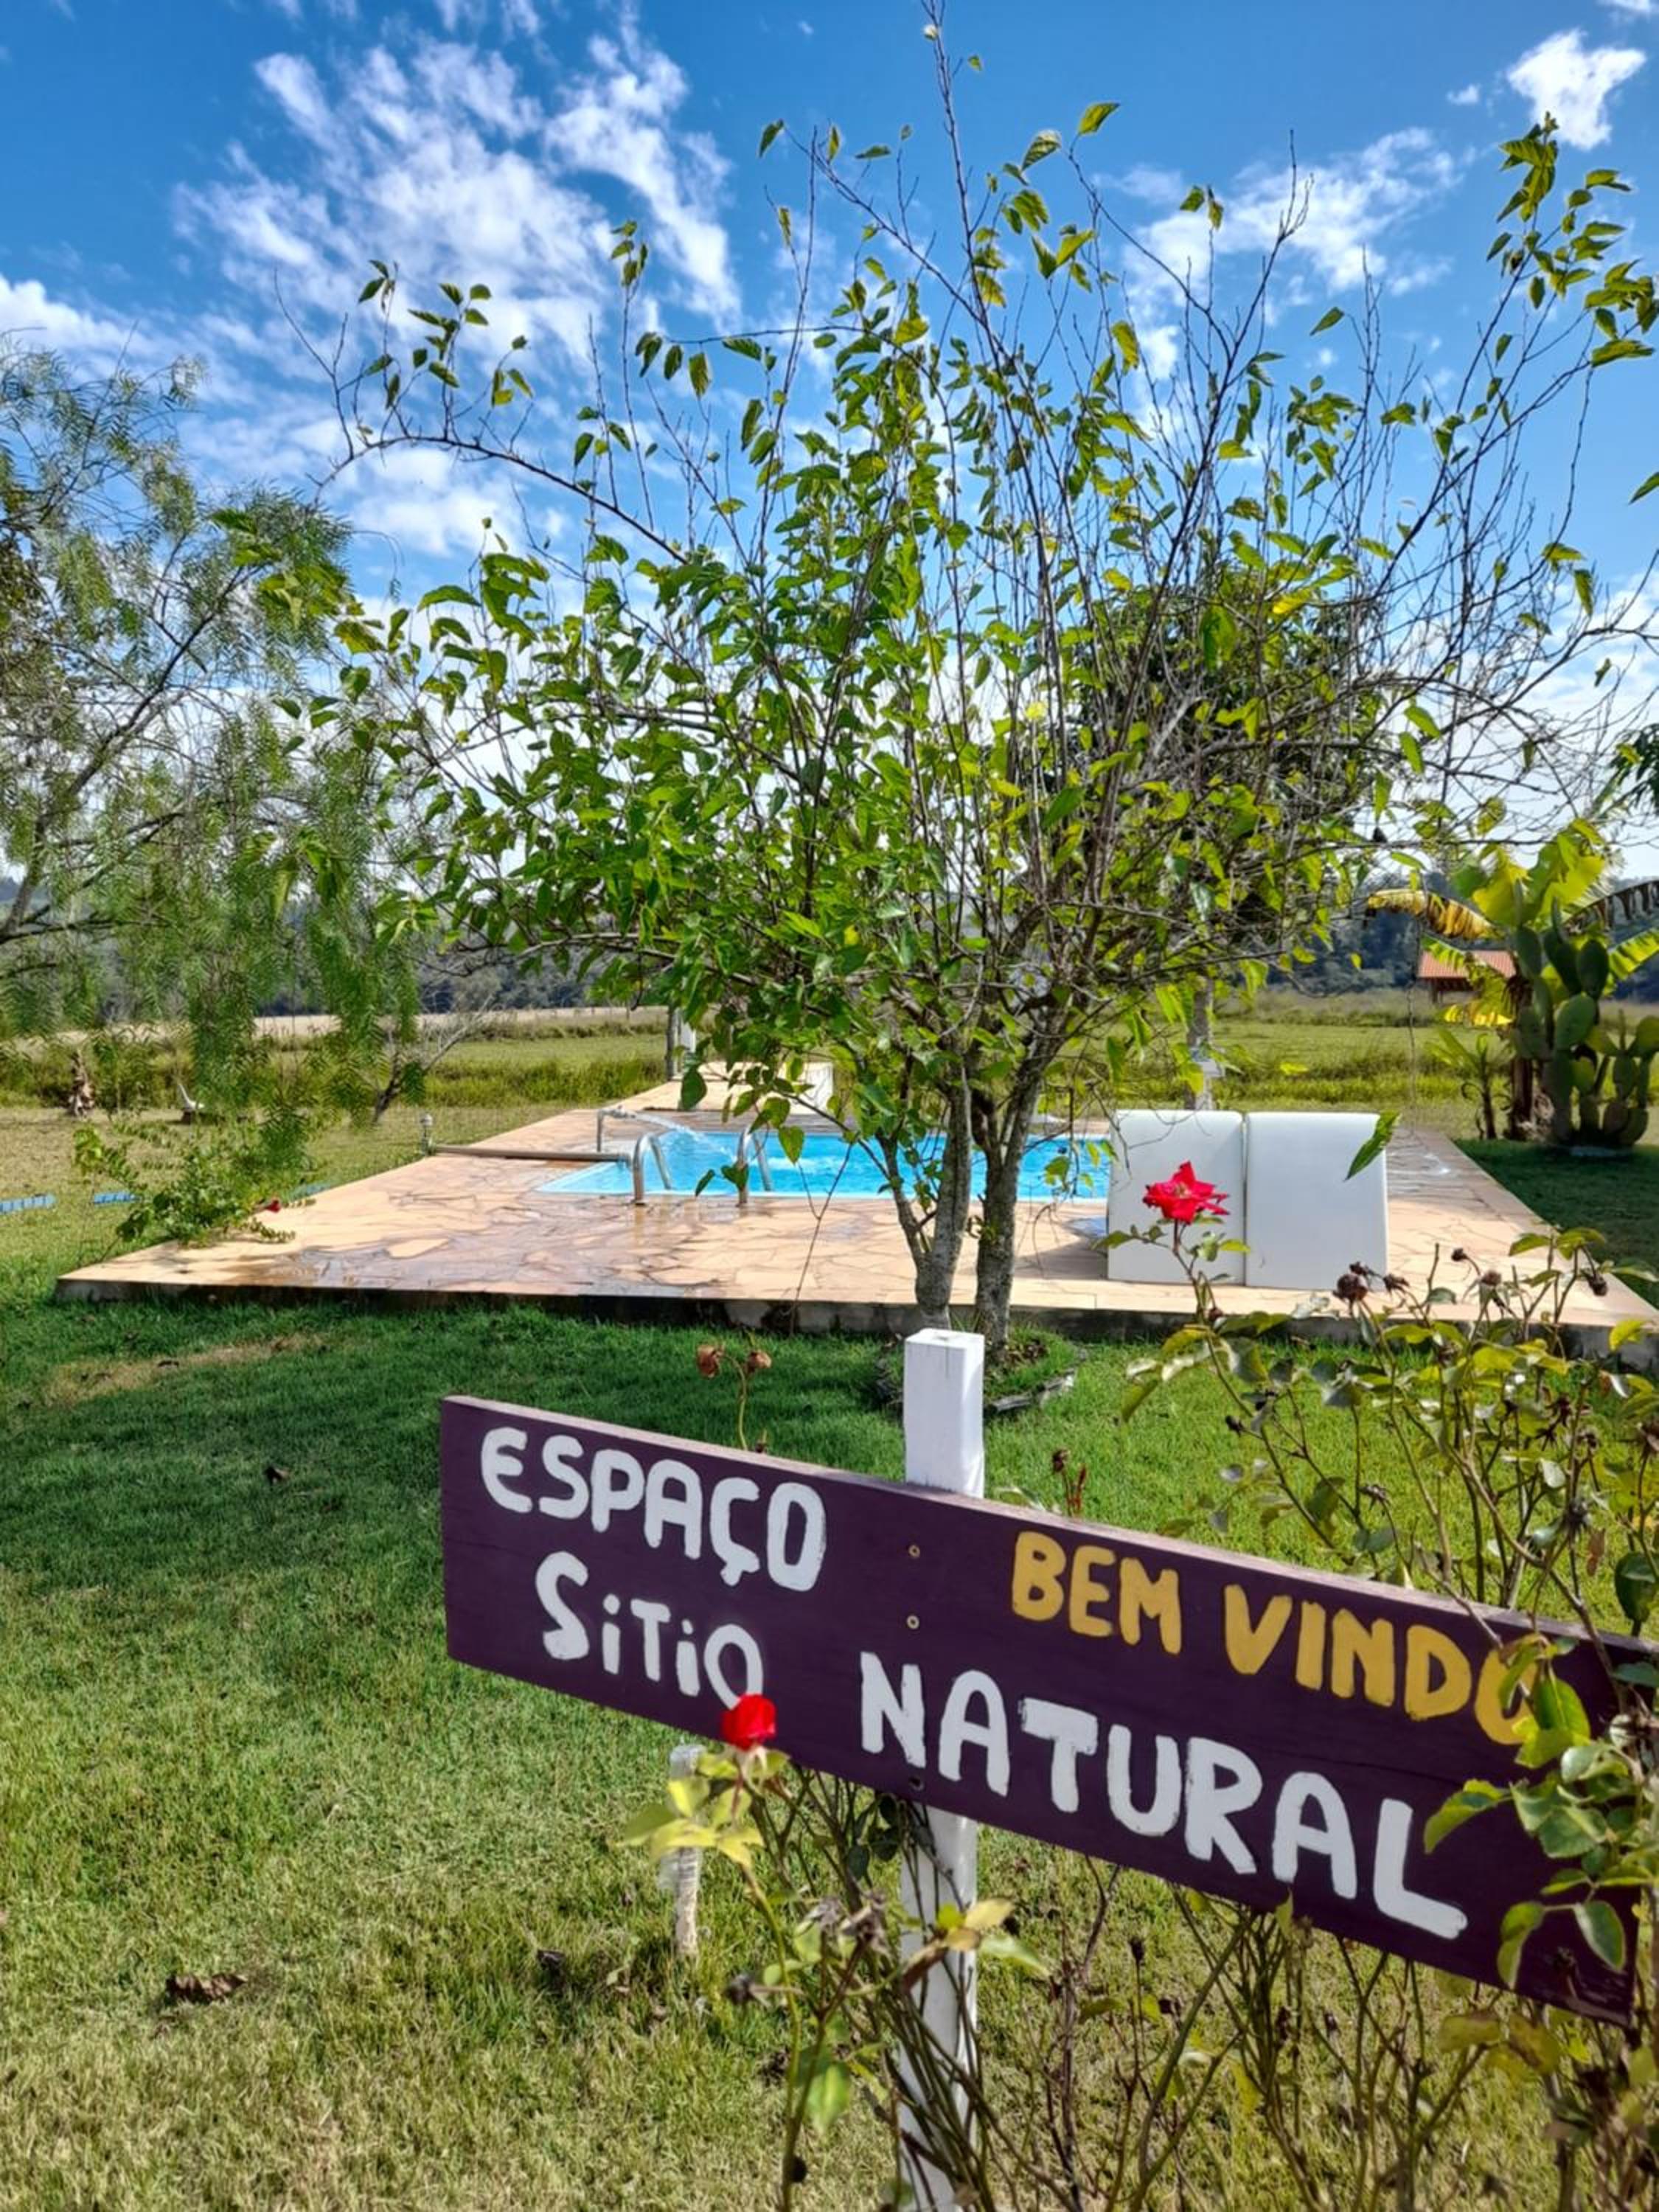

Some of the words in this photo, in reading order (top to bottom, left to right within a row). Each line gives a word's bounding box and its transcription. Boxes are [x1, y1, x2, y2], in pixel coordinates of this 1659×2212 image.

[480, 1427, 827, 1592] ESPAÇO
[1011, 1531, 1181, 1655] BEM
[860, 1651, 1468, 1940] NATURAL
